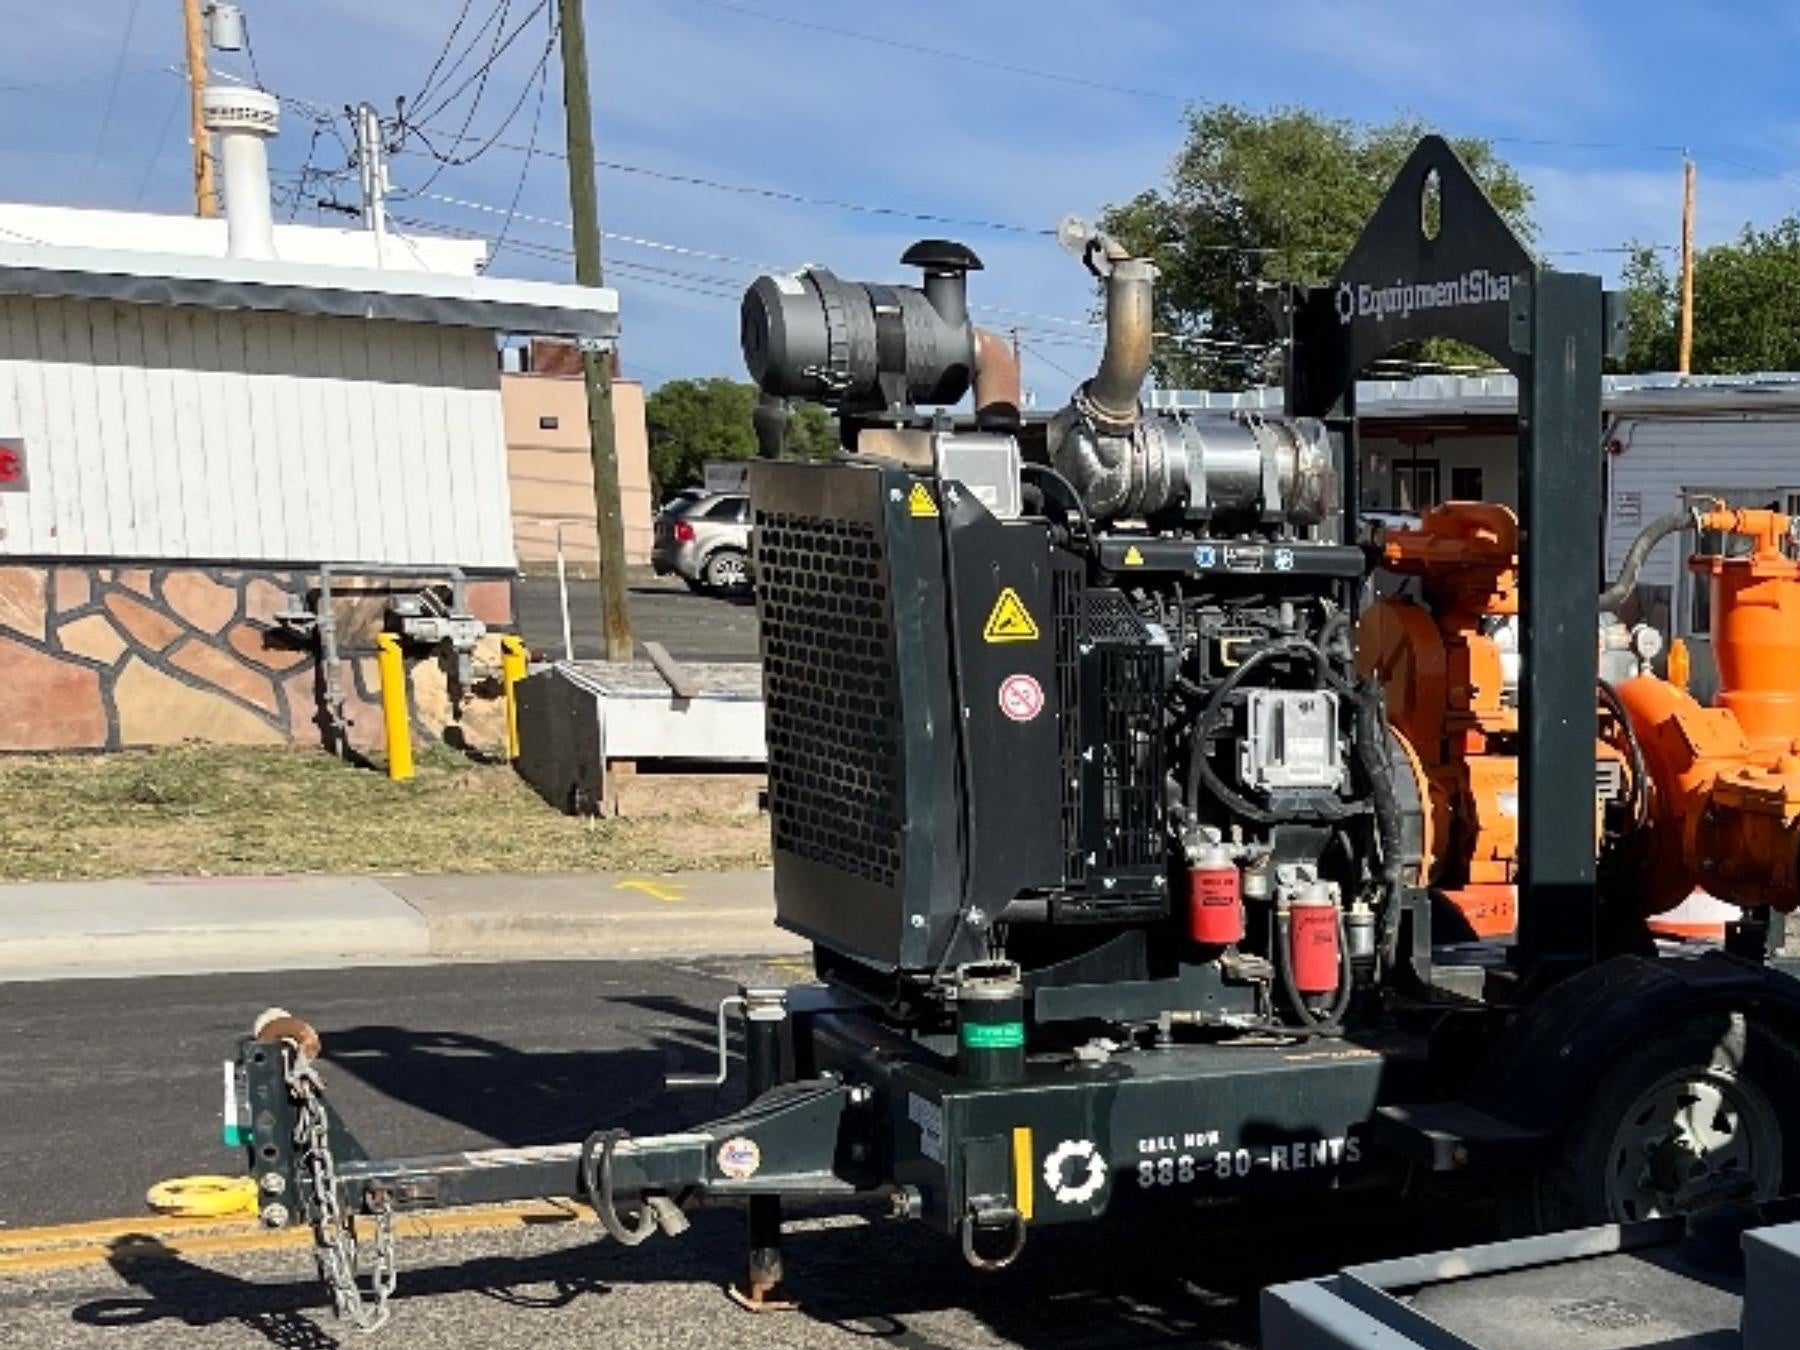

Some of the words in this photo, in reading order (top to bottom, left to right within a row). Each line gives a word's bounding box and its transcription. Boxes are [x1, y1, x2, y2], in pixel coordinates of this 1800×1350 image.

[1138, 1136, 1177, 1153] CALL
[1184, 1130, 1220, 1148] NOW
[1137, 1137, 1361, 1188] 888-80-RENTS
